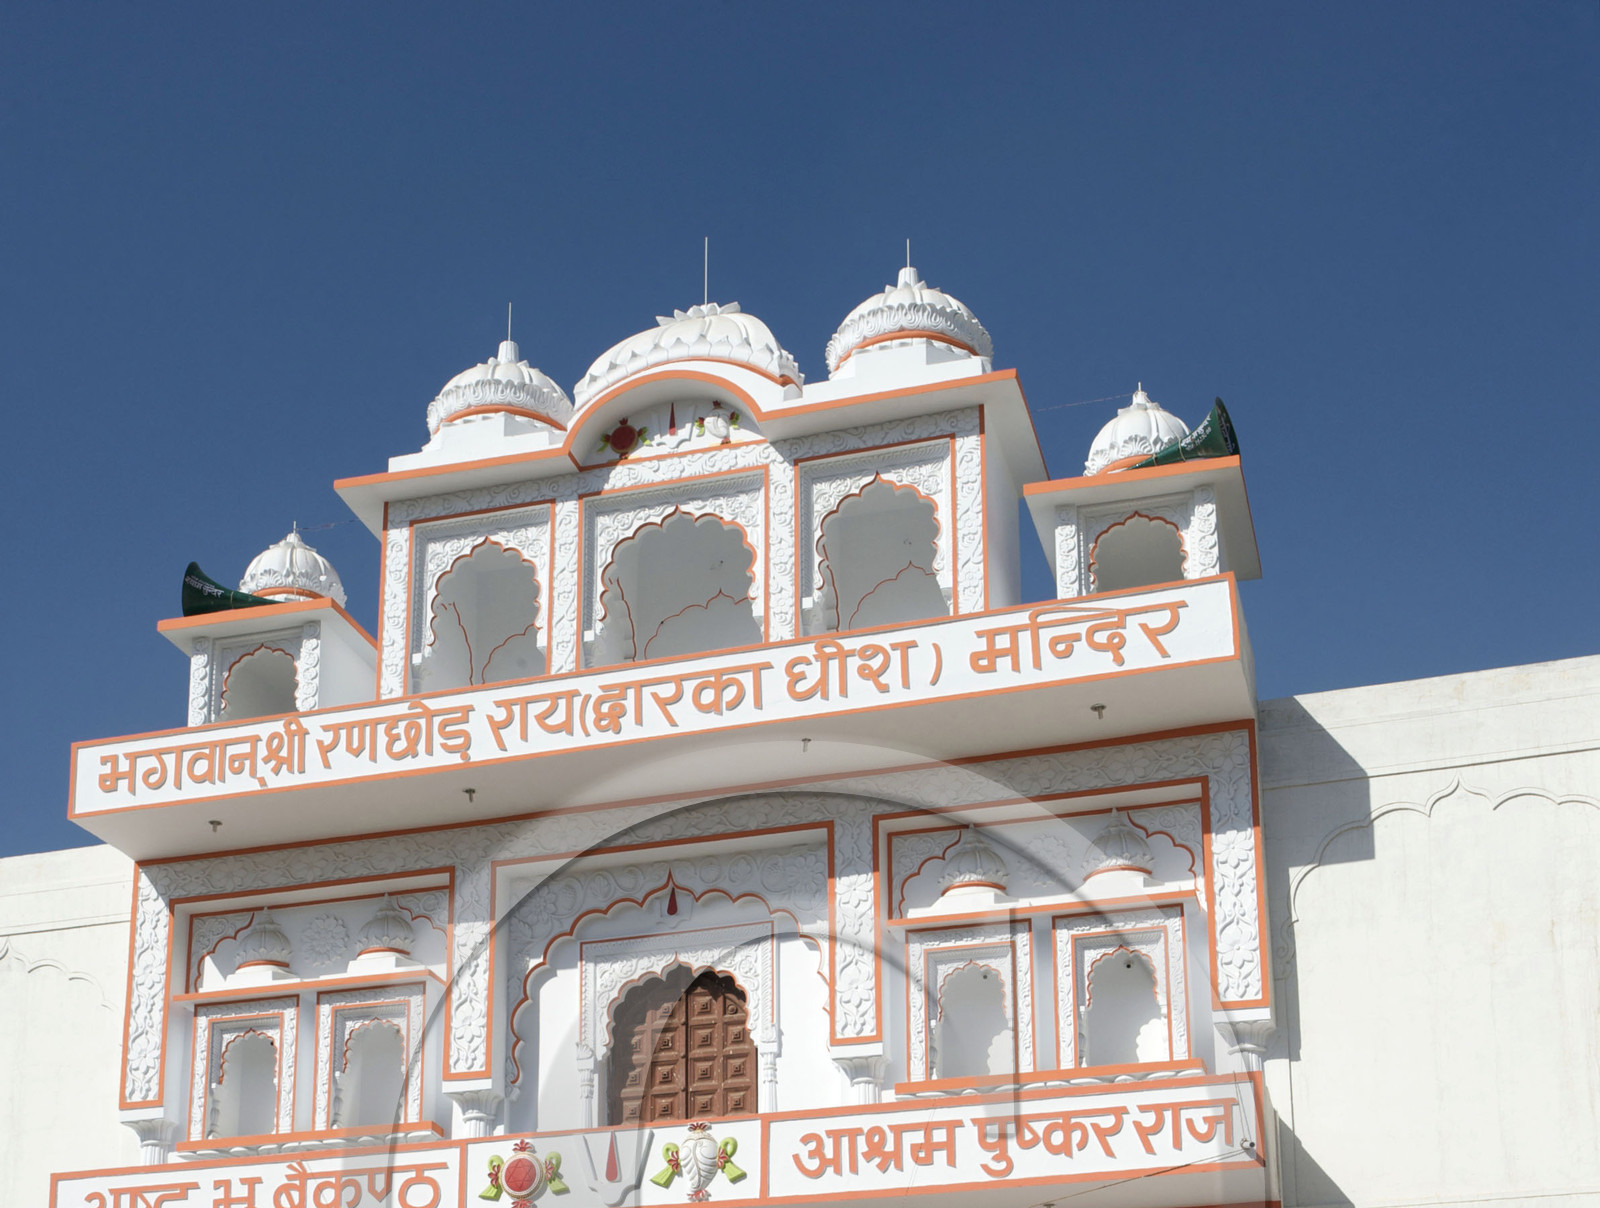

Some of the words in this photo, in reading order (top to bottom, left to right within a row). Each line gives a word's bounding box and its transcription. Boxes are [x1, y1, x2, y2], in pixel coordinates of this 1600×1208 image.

[315, 700, 475, 770] रणछोड़
[969, 600, 1189, 674] मन्दिर
[791, 1117, 964, 1180] आश्रम
[970, 1105, 1130, 1179] पुष्कर
[1132, 1097, 1239, 1156] राज
